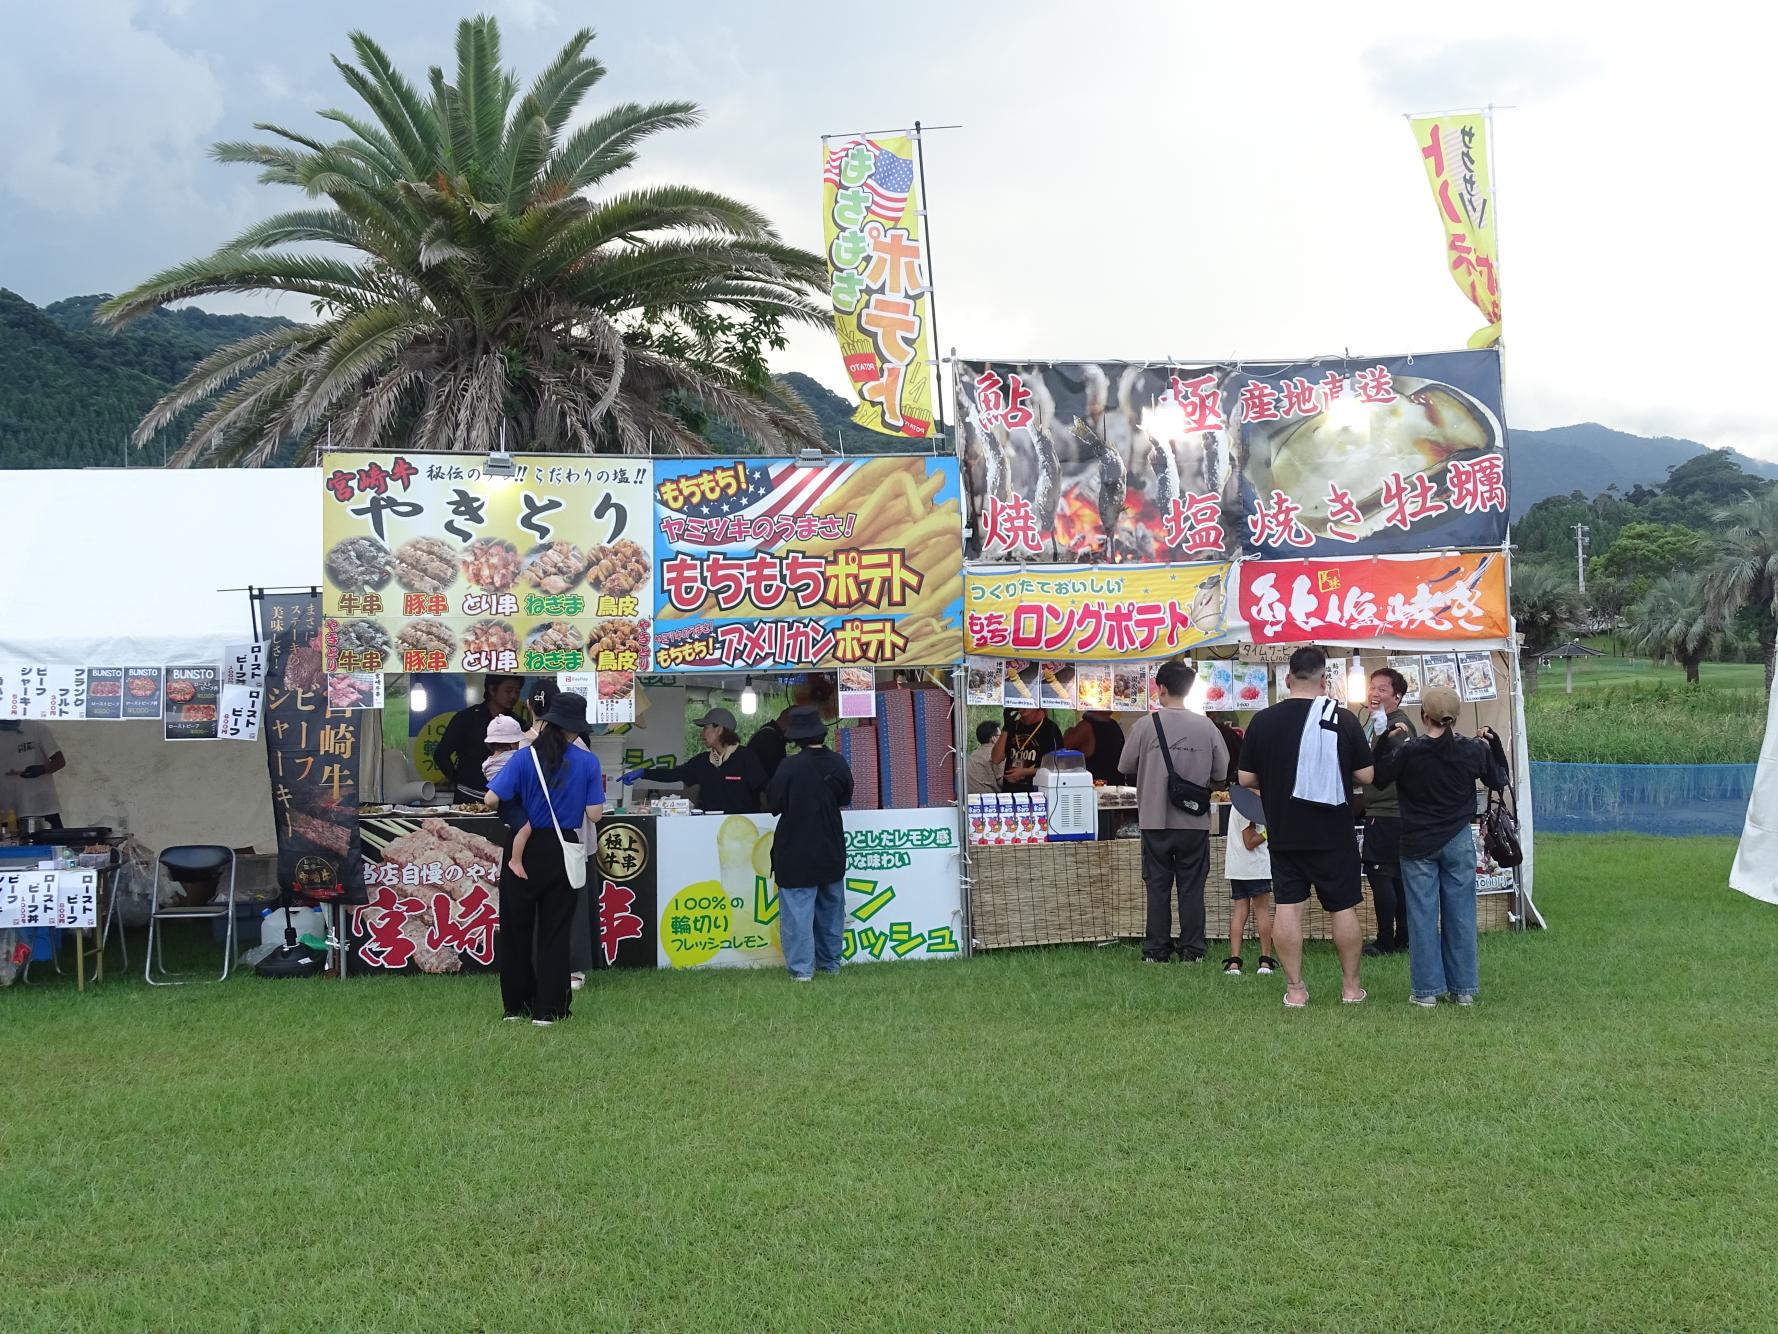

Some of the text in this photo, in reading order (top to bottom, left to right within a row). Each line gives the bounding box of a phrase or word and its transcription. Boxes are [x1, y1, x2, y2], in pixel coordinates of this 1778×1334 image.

[974, 370, 1035, 432] 鮎
[325, 456, 419, 502] 宮崎牛
[659, 462, 748, 512] もちもち!
[350, 488, 629, 546] やきとり
[1247, 454, 1507, 549] 焼き牡蠣
[660, 513, 857, 544] ヤミツキのうまさ!
[981, 492, 1044, 553] 焼
[1163, 492, 1226, 555] 塩
[660, 547, 925, 611] もちもちポテト
[970, 577, 1124, 603] つくりたておいしい
[338, 592, 384, 616] 牛串
[403, 592, 449, 616] 豚串
[461, 592, 519, 616] とり串
[524, 592, 585, 616] ねぎま
[596, 592, 638, 616] 鳥皮
[1248, 572, 1486, 637] 鮎塩焼き
[270, 606, 284, 669] 美味しさ!
[290, 604, 301, 666] ステーキの
[305, 603, 316, 641] まさに
[1012, 600, 1190, 653] ロングポテト
[325, 618, 339, 672] やきとり
[656, 637, 715, 669] もちもち!
[717, 617, 908, 668] アメリカンポテト
[1243, 644, 1300, 658] タイムサービ
[92, 669, 122, 677] BUNSTO
[173, 669, 214, 680] BUNSTO
[251, 645, 262, 680] ロースト
[338, 648, 384, 672] 牛串
[403, 648, 449, 672] 豚串
[461, 648, 519, 672] とり串
[524, 648, 585, 672] ねぎま
[596, 648, 638, 672] 鳥皮
[19, 667, 33, 716] ジャーキー
[35, 667, 48, 696] ビーフ
[73, 668, 85, 707] フランク
[58, 688, 70, 717] フルト
[245, 690, 260, 728] ロースト
[229, 707, 243, 736] ビーフ
[294, 681, 320, 781] ビーフ
[268, 687, 293, 838] ジャーキー
[604, 832, 640, 855] 極上
[603, 853, 639, 872] 牛串
[7, 874, 20, 904] ビーフ
[27, 883, 40, 924] ビーフ丼
[43, 874, 55, 913] ロースト
[82, 875, 93, 914] ロースト
[673, 896, 744, 911] 100%の
[754, 875, 896, 925] レン
[67, 894, 79, 924] ビーフ
[671, 914, 729, 935] 輪切り
[671, 935, 769, 953] フレッシュレモン
